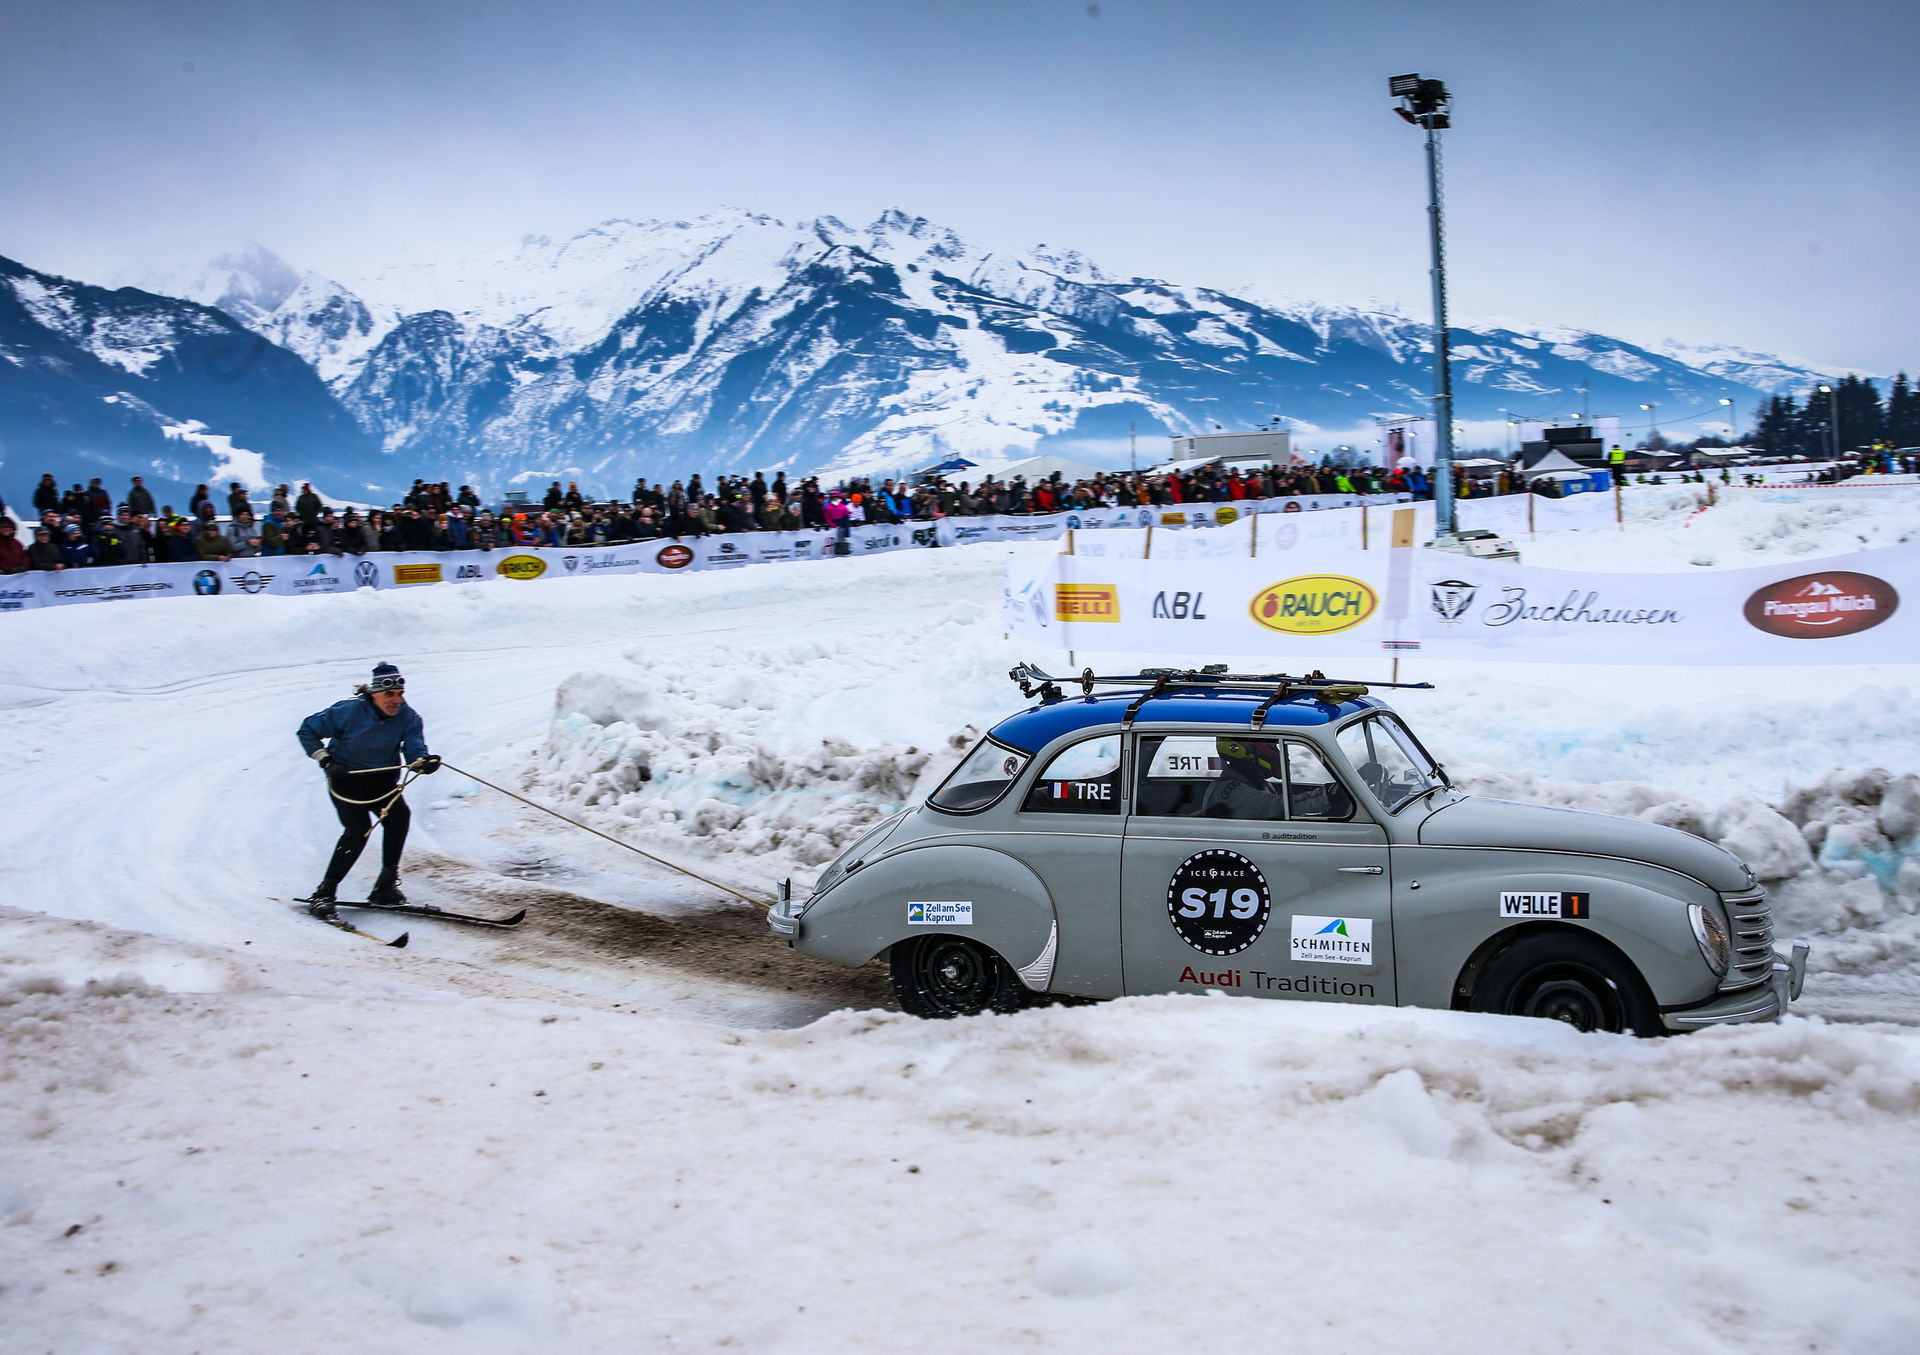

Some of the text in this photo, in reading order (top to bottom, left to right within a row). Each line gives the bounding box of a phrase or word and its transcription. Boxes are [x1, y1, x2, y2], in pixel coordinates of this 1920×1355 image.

[509, 561, 541, 573] RAUCH
[55, 585, 122, 597] PORSCHE
[124, 582, 173, 593] DESIGN
[1280, 591, 1363, 617] RAUCH
[1480, 586, 1687, 627] Backhausen
[1763, 594, 1876, 617] Pinzgau Milch
[1075, 783, 1112, 800] TRE
[1272, 832, 1317, 840] auditradition
[926, 903, 941, 912] Zell
[955, 903, 971, 912] See
[1178, 887, 1260, 919] S19
[1504, 895, 1580, 916] WELLE 1
[926, 913, 955, 924] Kaprun
[1293, 938, 1370, 953] SCHMITTEN
[1178, 966, 1375, 998] Audi Tradition
